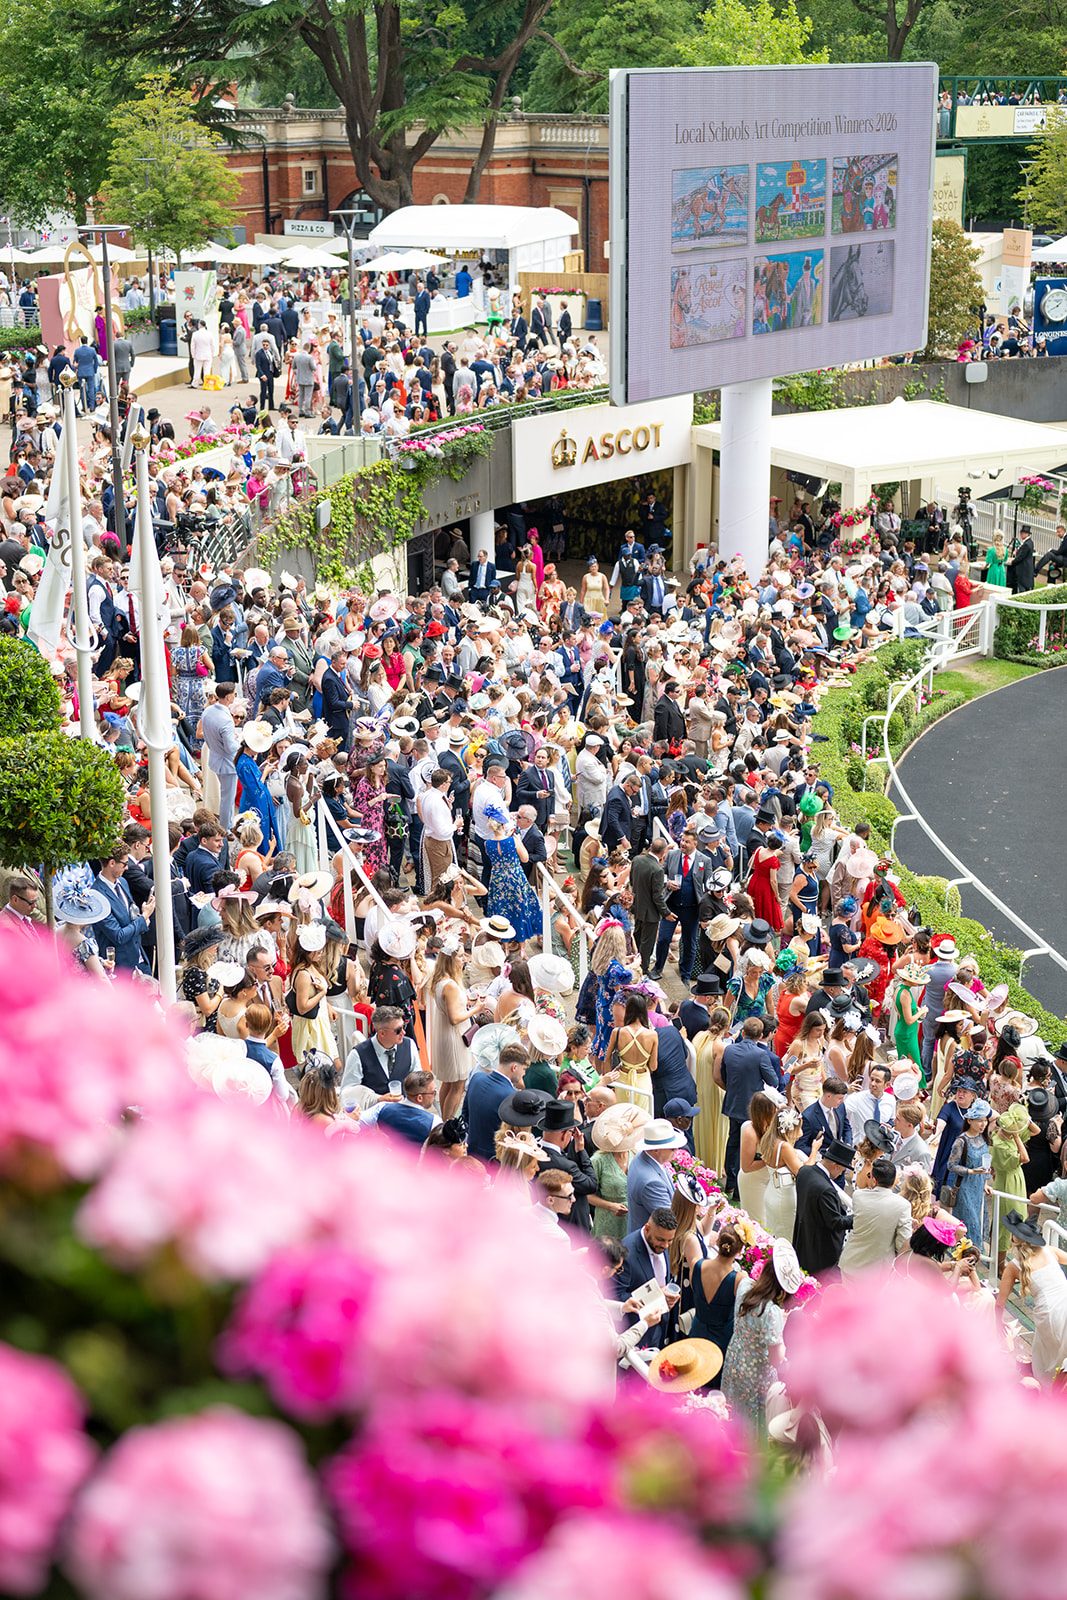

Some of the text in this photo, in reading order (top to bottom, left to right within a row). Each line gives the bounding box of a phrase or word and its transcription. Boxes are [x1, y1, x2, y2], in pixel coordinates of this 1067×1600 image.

[675, 112, 898, 144] Local Schools Art Competition Winners 2026
[291, 224, 309, 232] PIZZA
[315, 225, 325, 233] CO
[692, 273, 725, 298] Royal
[691, 294, 722, 314] Ascot
[581, 421, 665, 464] ASCOT
[456, 499, 481, 518] BAR
